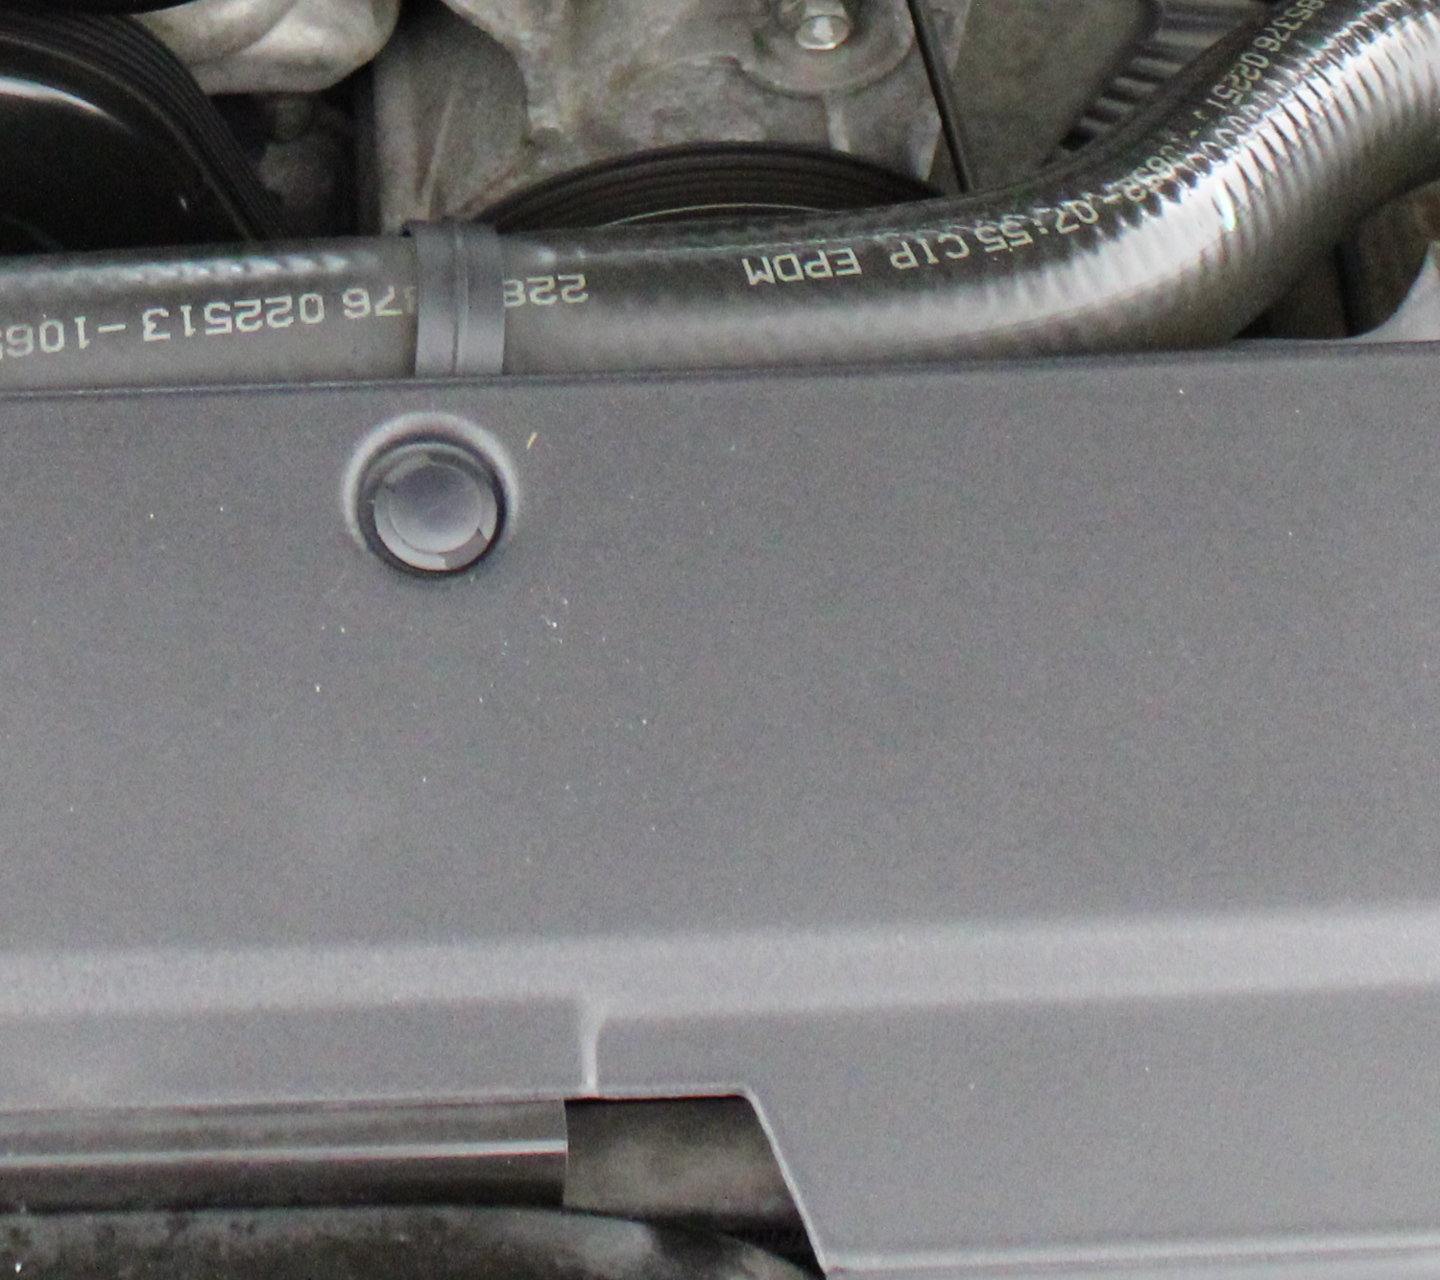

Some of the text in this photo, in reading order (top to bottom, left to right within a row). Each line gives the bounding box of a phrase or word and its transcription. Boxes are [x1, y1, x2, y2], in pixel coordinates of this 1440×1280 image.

[741, 246, 863, 286] EPDM
[889, 232, 970, 269] CIP
[142, 292, 325, 341] 022513
